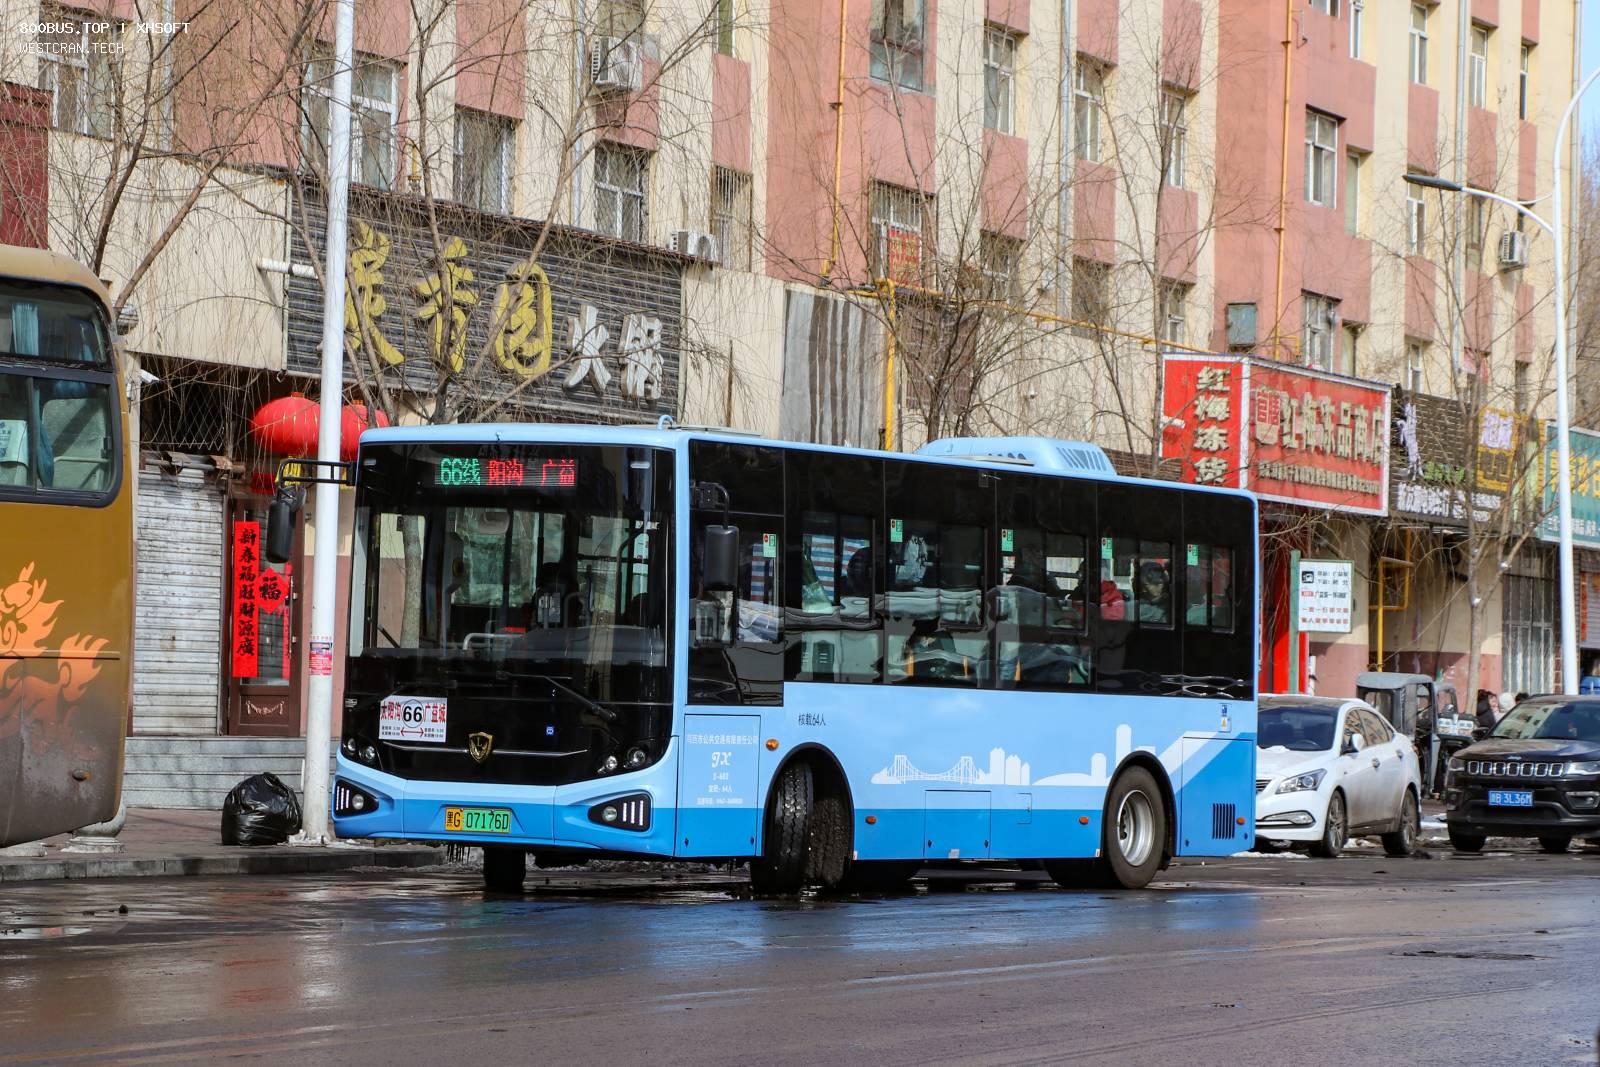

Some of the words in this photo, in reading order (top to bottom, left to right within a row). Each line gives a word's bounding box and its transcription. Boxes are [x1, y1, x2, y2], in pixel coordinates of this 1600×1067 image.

[439, 457, 481, 486] 66线
[258, 576, 283, 601] 福
[403, 705, 423, 723] 66
[798, 712, 827, 727] 核载64人
[446, 811, 461, 828] 黑G
[466, 811, 509, 830] 07176D
